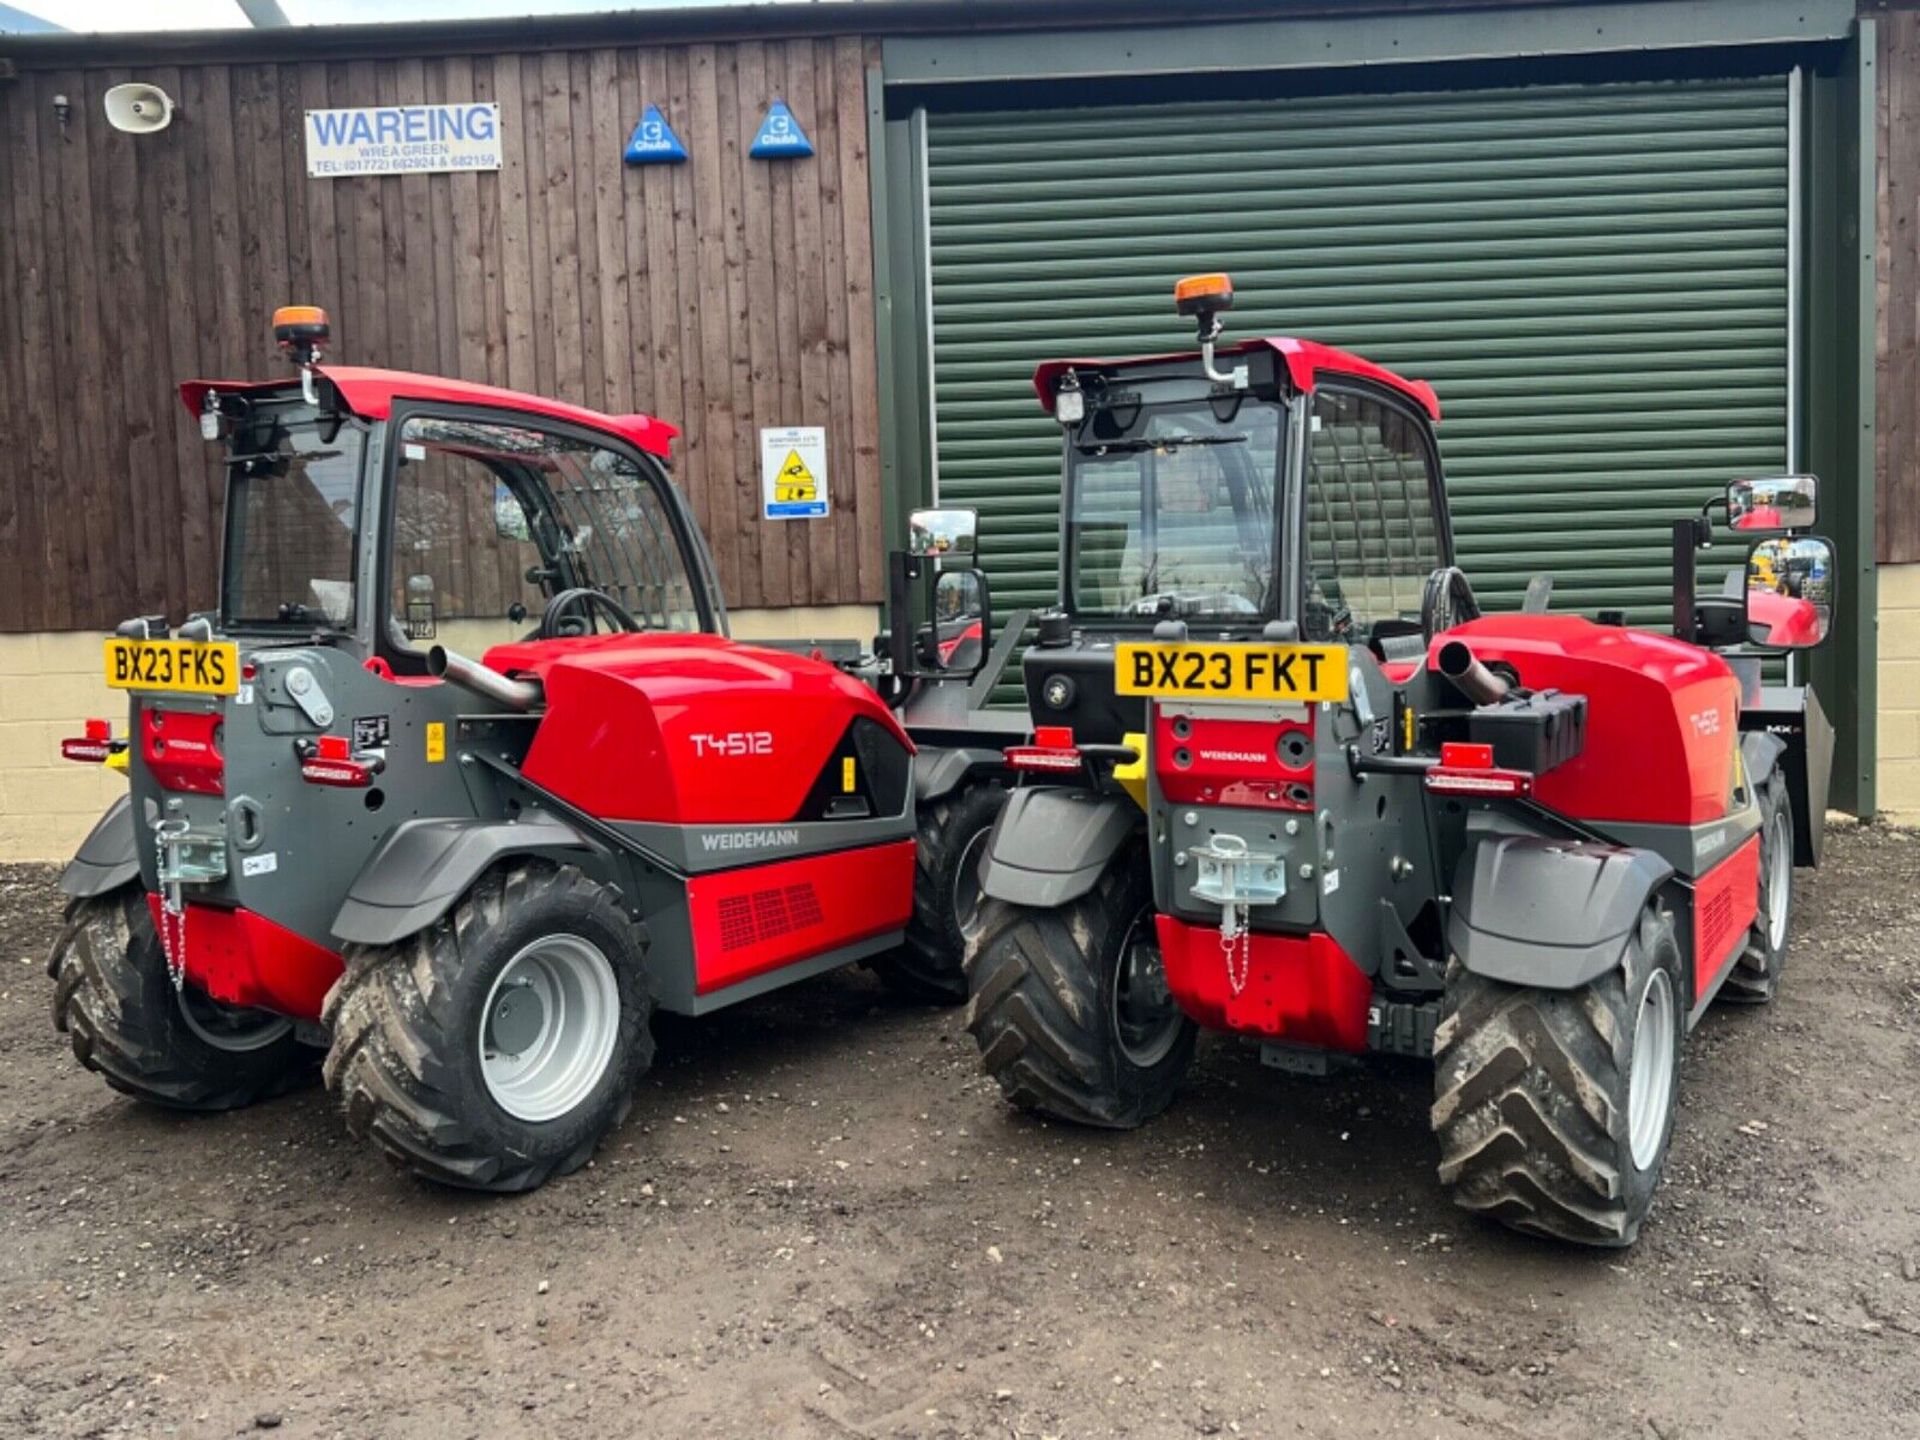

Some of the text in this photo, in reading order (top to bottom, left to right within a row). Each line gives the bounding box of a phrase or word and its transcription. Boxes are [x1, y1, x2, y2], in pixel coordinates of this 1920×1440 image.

[313, 106, 494, 146] WAREING
[358, 143, 450, 157] WREA GREEN
[115, 646, 225, 686] BX23 FKS
[1132, 651, 1325, 692] BX23 FKT
[689, 731, 774, 757] T4512
[701, 829, 800, 851] WEIDEMANN
